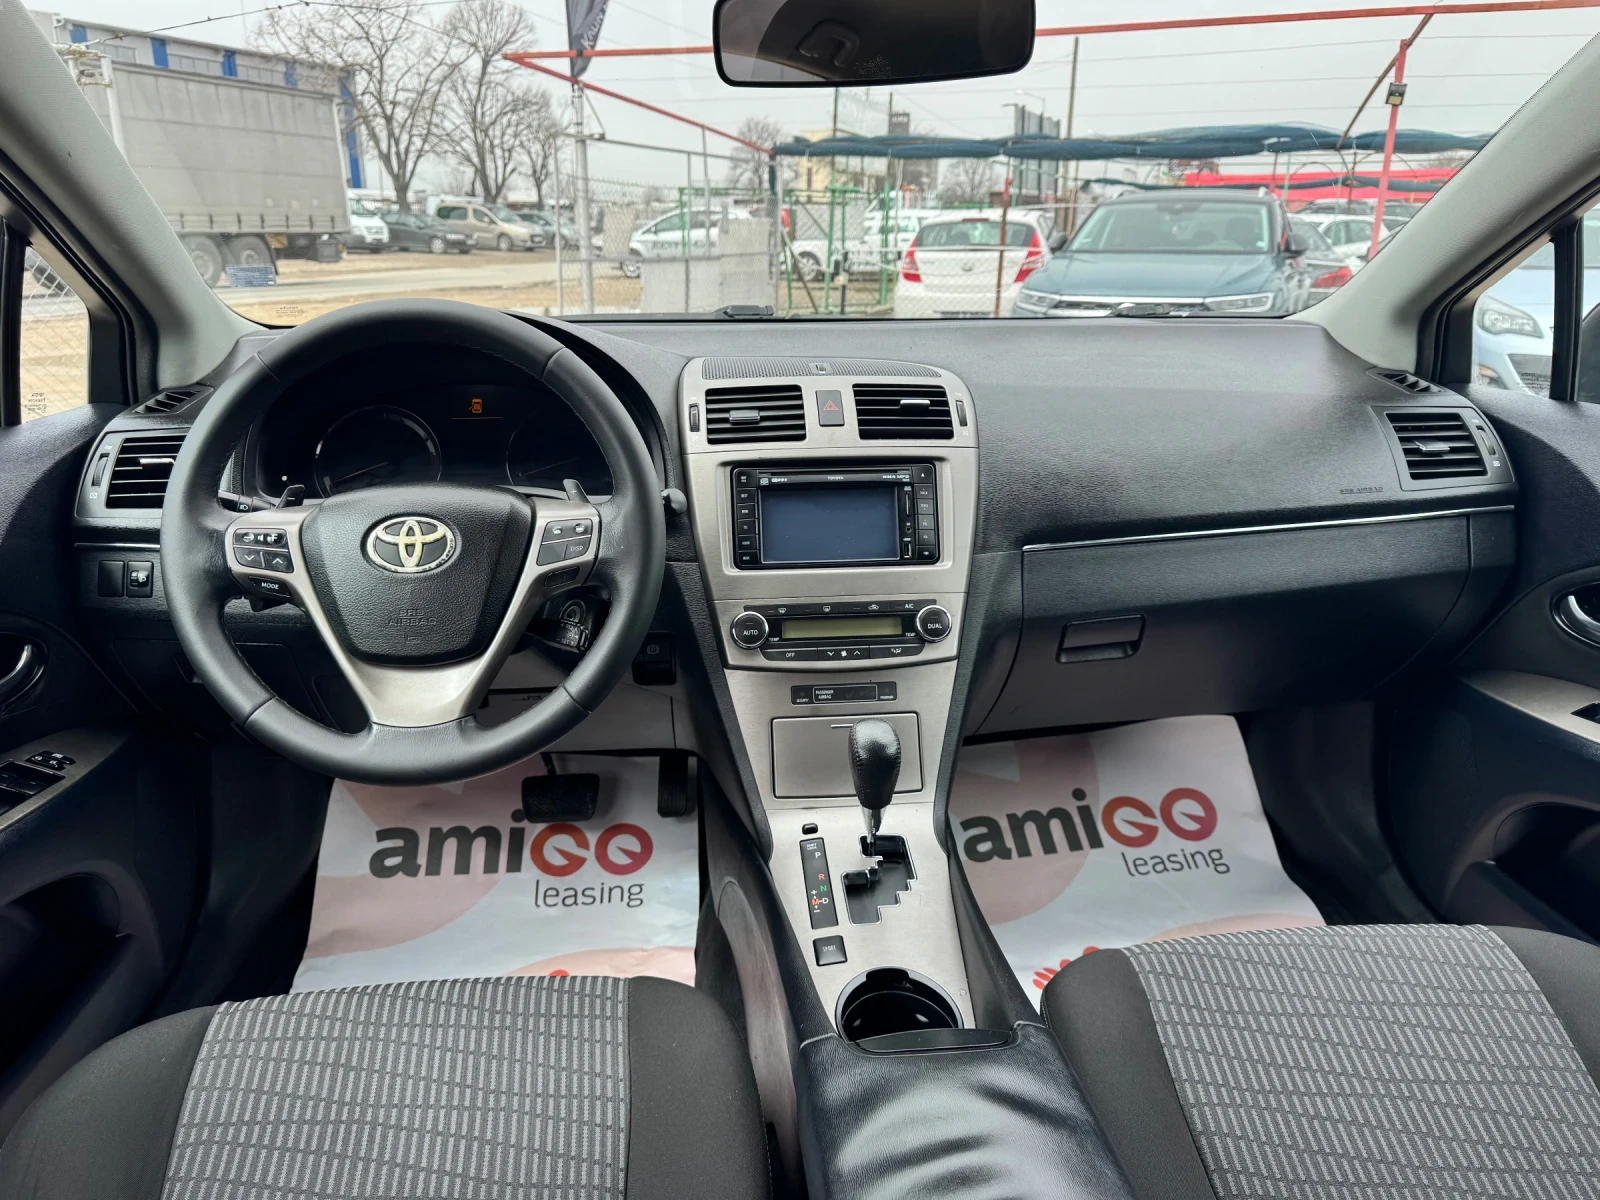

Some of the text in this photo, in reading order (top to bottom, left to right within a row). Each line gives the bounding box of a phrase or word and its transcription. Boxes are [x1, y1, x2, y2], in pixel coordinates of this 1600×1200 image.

[261, 582, 280, 590] MODE
[388, 617, 437, 626] AIRBAG
[1121, 849, 1230, 877] leasing
[534, 879, 645, 908] leasing
[811, 898, 820, 906] M
